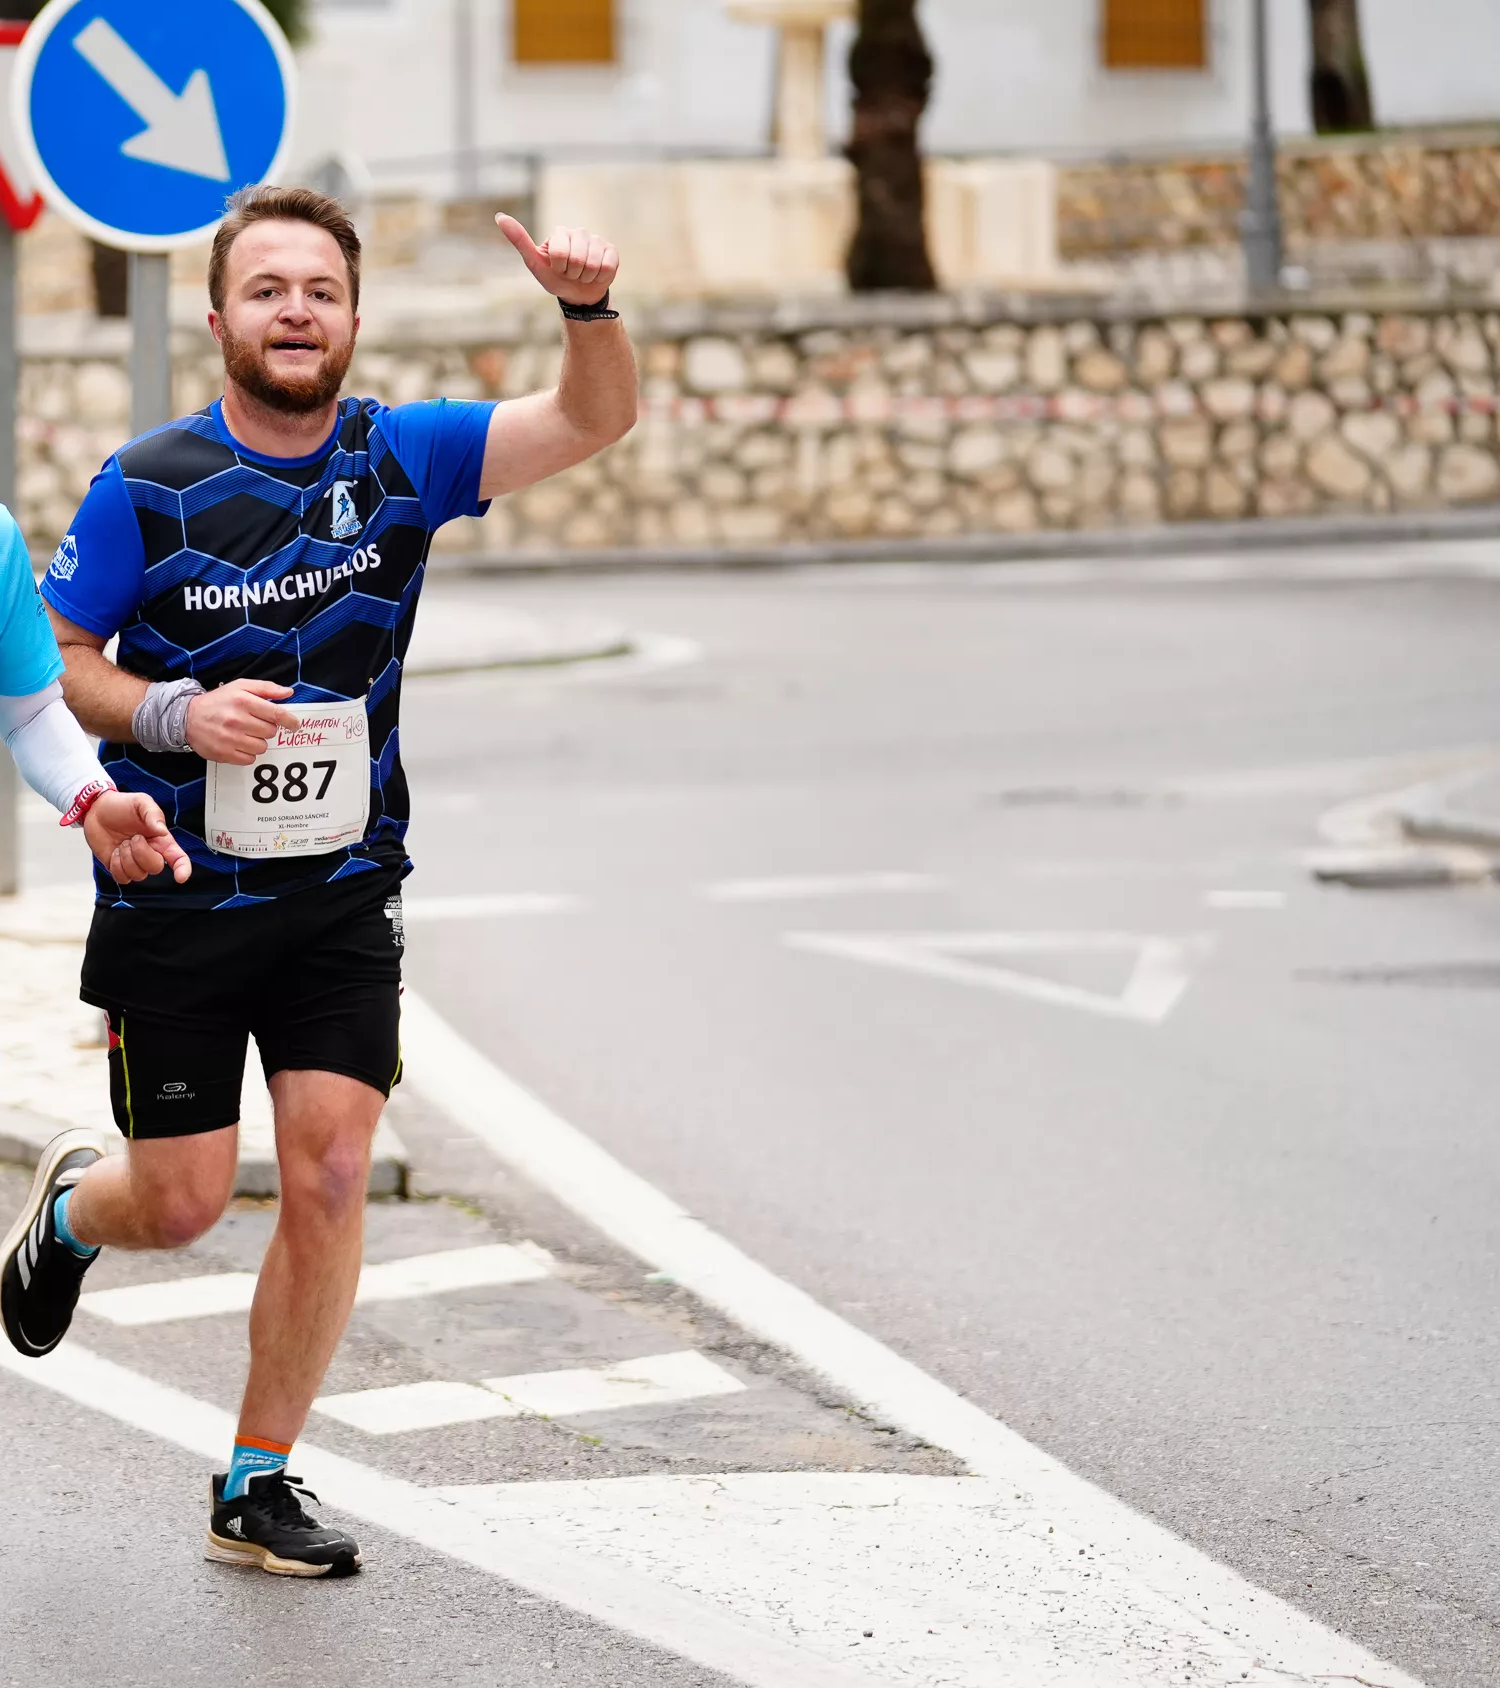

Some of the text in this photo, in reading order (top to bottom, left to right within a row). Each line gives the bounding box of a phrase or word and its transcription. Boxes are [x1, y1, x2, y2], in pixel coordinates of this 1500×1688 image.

[183, 543, 382, 611] HORNACHUELOS
[301, 717, 341, 730] MARATÓN
[277, 731, 328, 747] LUCENA
[251, 759, 337, 804] 887
[278, 813, 304, 821] SORIANO
[304, 811, 330, 820] SÁNCHEZ
